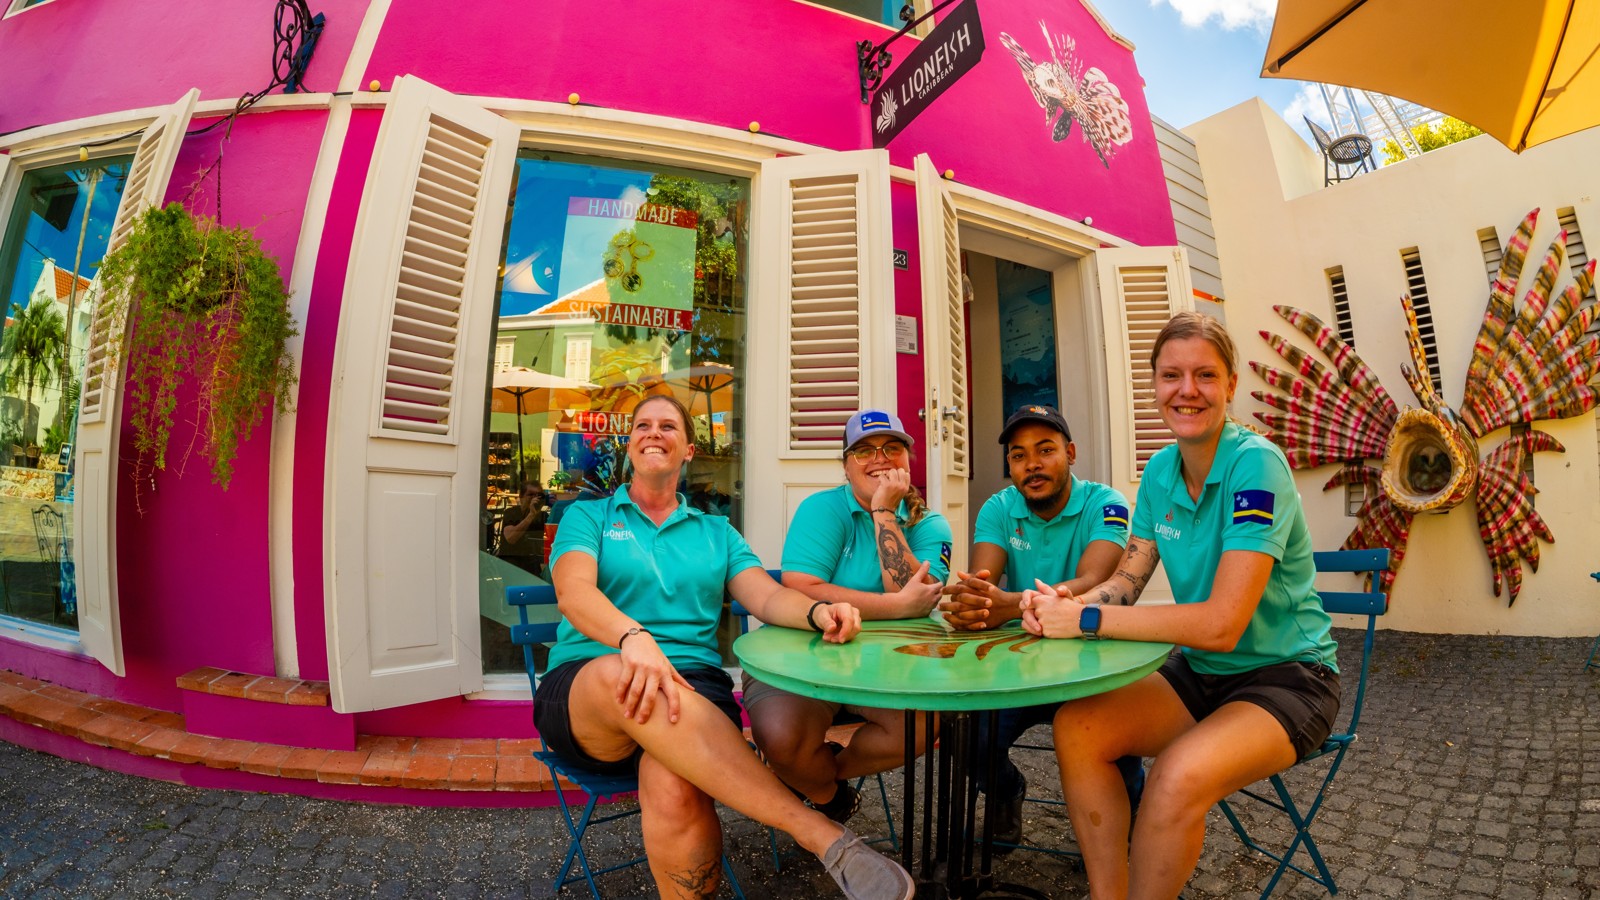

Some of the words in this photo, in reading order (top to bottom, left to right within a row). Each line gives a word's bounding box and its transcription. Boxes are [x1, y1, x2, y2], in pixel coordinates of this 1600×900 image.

[901, 23, 971, 106] LIONFISH
[918, 63, 954, 99] CARIBBEAN
[588, 199, 679, 225] HANDMADE
[893, 252, 906, 266] 23
[568, 301, 682, 329] SUSTAINABLE
[578, 411, 633, 433] LIONF
